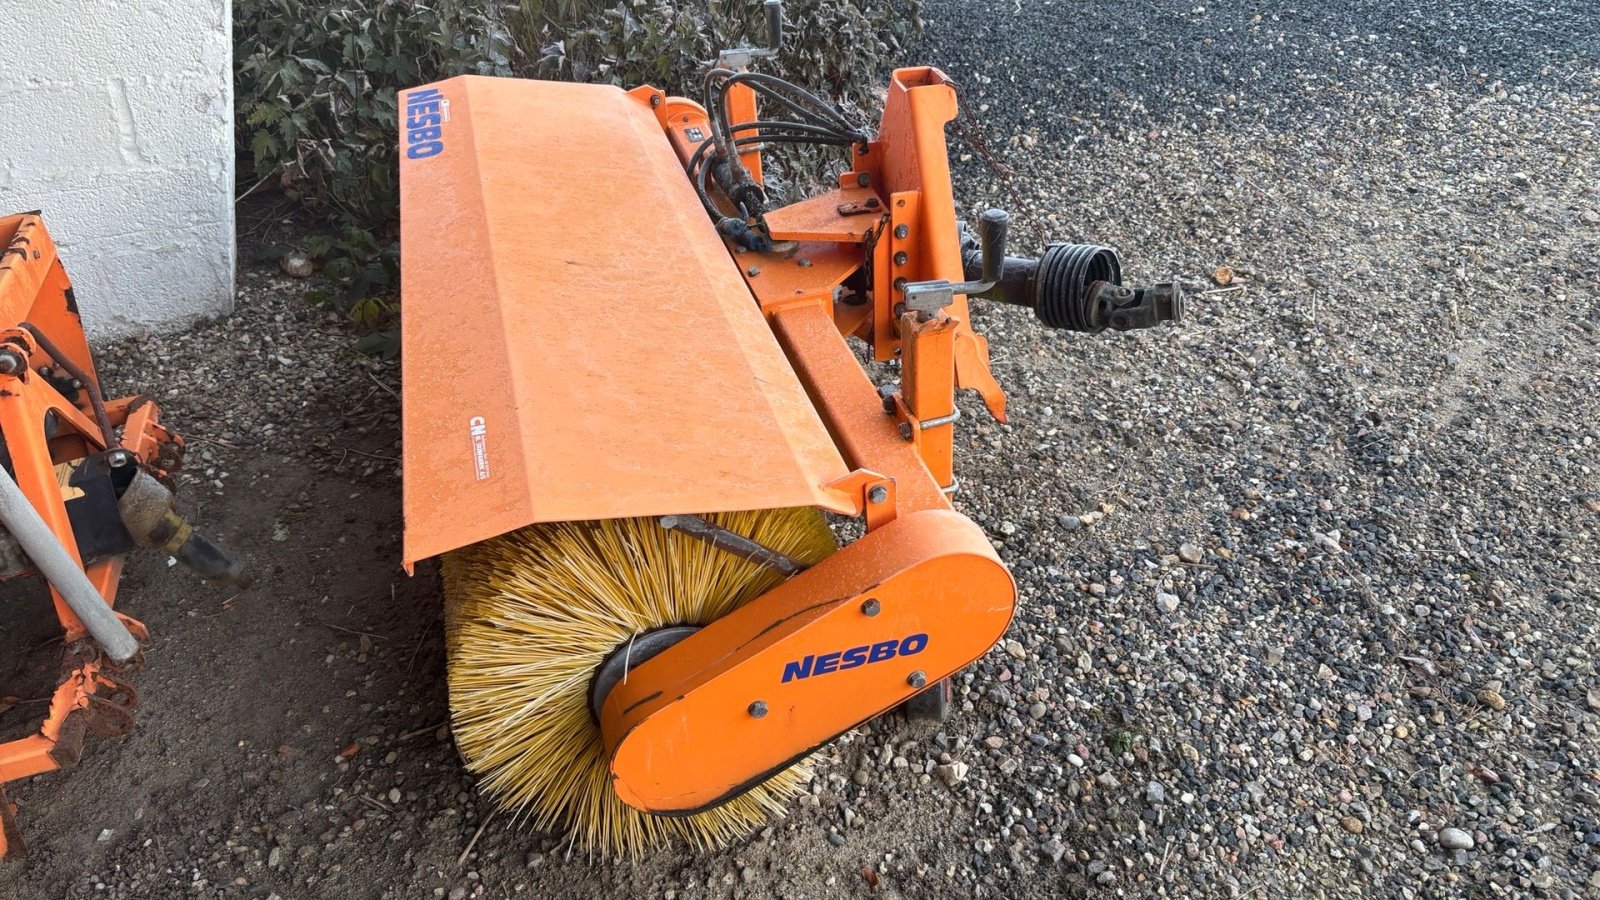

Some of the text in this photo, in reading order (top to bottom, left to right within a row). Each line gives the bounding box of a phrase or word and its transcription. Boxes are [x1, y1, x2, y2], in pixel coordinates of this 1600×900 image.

[407, 88, 444, 159] NESBO
[469, 416, 486, 436] CN
[781, 633, 929, 683] NESBO
